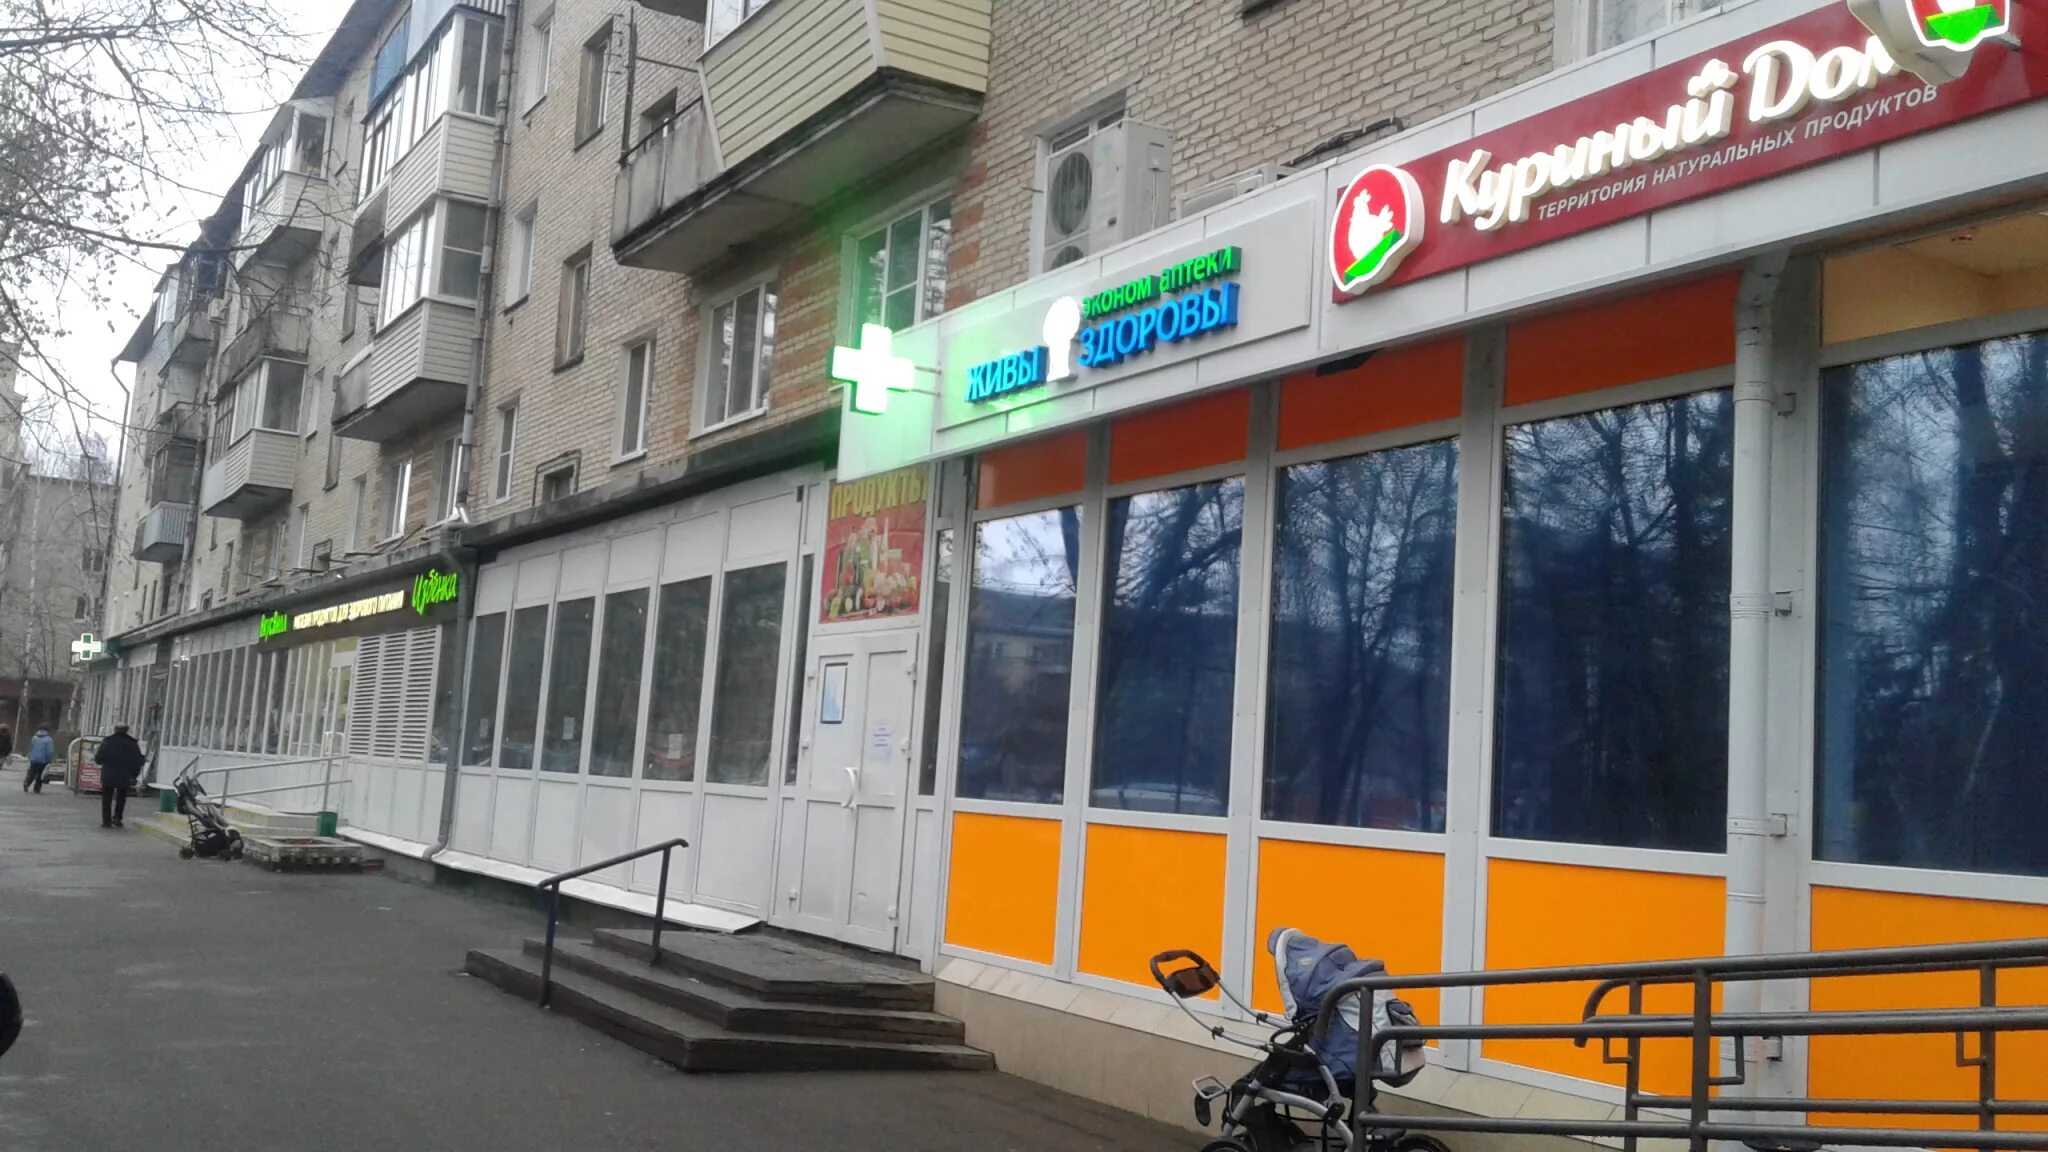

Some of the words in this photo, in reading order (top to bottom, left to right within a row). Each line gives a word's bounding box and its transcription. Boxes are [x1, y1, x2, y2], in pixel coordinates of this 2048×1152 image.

[1440, 58, 1738, 231] Куриный
[1538, 174, 1647, 221] ТЕРРИТОРИЯ
[1652, 127, 1797, 185] НАТУРАЛЬНЫХ
[1804, 84, 1938, 139] ПРОДУКТОВ
[964, 346, 1046, 403] ЖИВЫ
[1077, 281, 1240, 368] ЗДОРОВЫ
[1082, 275, 1157, 319] эконом
[1159, 246, 1241, 294] аптеки
[830, 467, 927, 520] ПРОДУКТЫ
